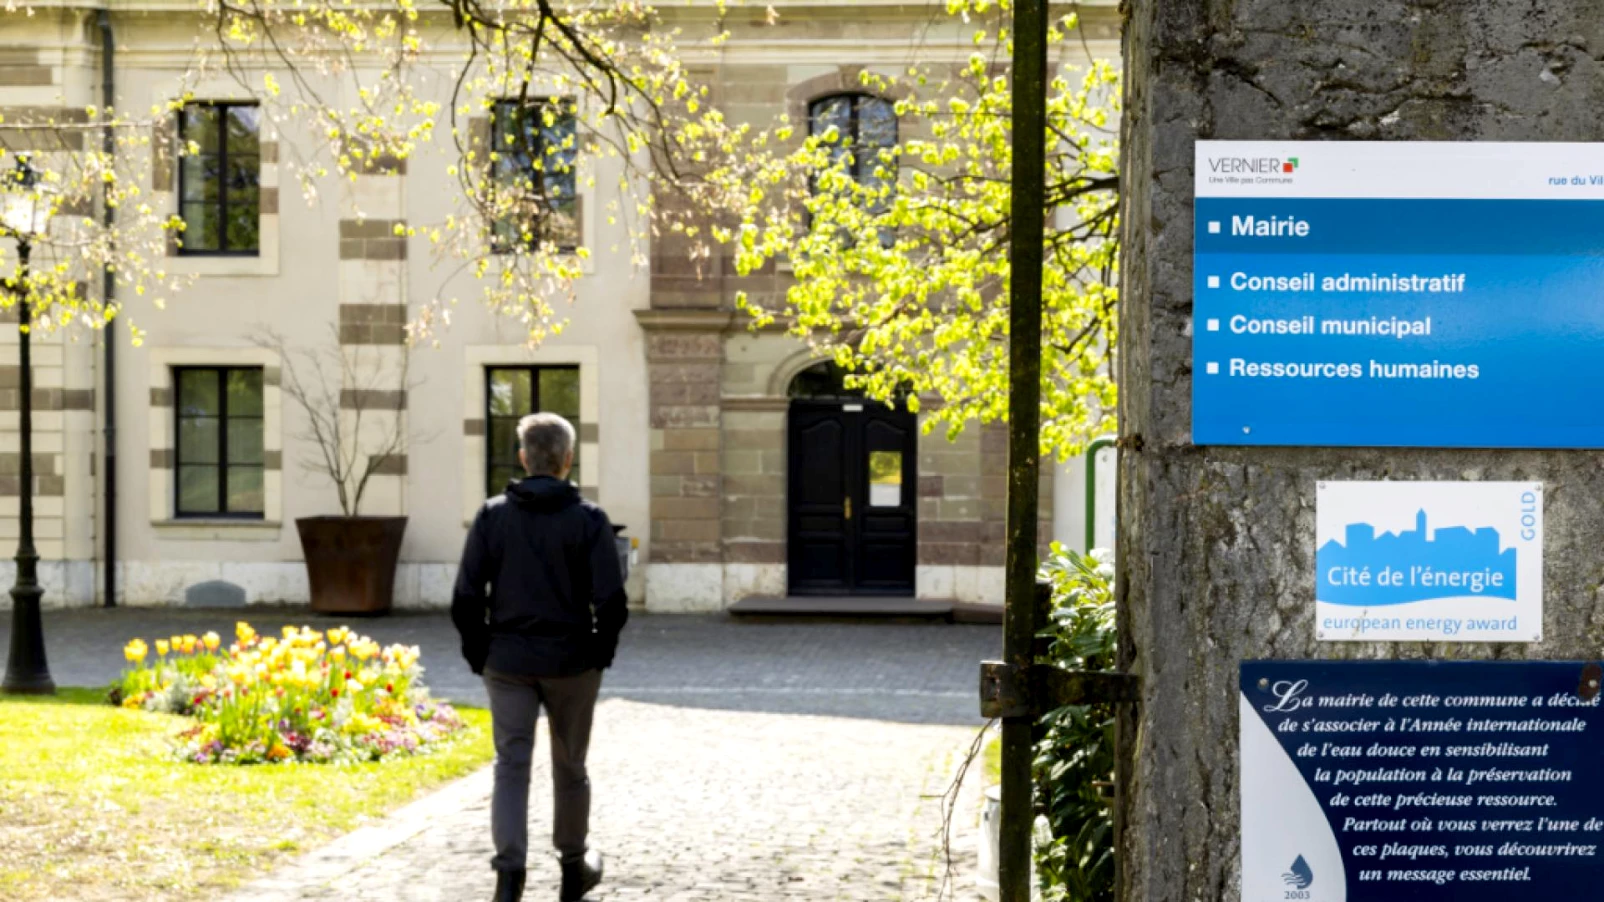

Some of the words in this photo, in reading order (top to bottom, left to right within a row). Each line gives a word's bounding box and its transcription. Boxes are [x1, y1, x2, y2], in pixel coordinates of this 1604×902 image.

[1209, 158, 1280, 173] VERNIER
[1571, 176, 1585, 185] du
[1232, 216, 1309, 236] Mairie
[1231, 272, 1314, 291] Conseil
[1322, 273, 1465, 292] administratif
[1230, 315, 1314, 334] Conseil
[1322, 316, 1431, 338] municipal
[1230, 358, 1362, 377] Ressources
[1370, 360, 1479, 378] humaines
[1521, 491, 1536, 541] GOLD
[1328, 567, 1371, 585] Cité
[1377, 566, 1403, 586] de
[1411, 566, 1503, 592] l'énergie
[1323, 617, 1400, 633] european
[1406, 619, 1462, 635] energy
[1467, 616, 1516, 631] award
[1263, 679, 1313, 712] La
[1318, 693, 1375, 708] mairie
[1377, 692, 1399, 708] de
[1402, 694, 1441, 707] cette
[1443, 695, 1528, 707] commune
[1531, 696, 1544, 707] a
[1277, 717, 1299, 732] de
[1301, 717, 1381, 733] s'associer
[1383, 717, 1396, 732] à
[1399, 717, 1463, 732] l'Année
[1466, 717, 1587, 732] internationale
[1296, 742, 1318, 757] de
[1320, 742, 1362, 757] l'eau
[1365, 742, 1417, 757] douce
[1420, 745, 1441, 757] en
[1444, 742, 1549, 757] sensibilisant
[1314, 767, 1331, 782] la
[1333, 767, 1427, 786] population
[1430, 767, 1443, 782] à
[1446, 767, 1464, 781] la
[1465, 766, 1572, 786] préservation
[1329, 792, 1350, 807] de
[1354, 793, 1392, 807] cette
[1393, 792, 1473, 811] précieuse
[1476, 795, 1557, 806] ressource.
[1342, 816, 1407, 832] Partout
[1410, 816, 1433, 831] où
[1437, 820, 1477, 832] vous
[1481, 820, 1534, 832] verrez
[1537, 816, 1580, 832] l'une
[1583, 816, 1604, 832] de
[1352, 845, 1378, 856] ces
[1379, 841, 1449, 860] plaques,
[1454, 844, 1494, 856] vous
[1497, 841, 1597, 856] découvrirez
[1358, 869, 1382, 881] un
[1387, 869, 1456, 885] message
[1459, 866, 1531, 881] essentiel.
[1285, 891, 1310, 899] 2003
